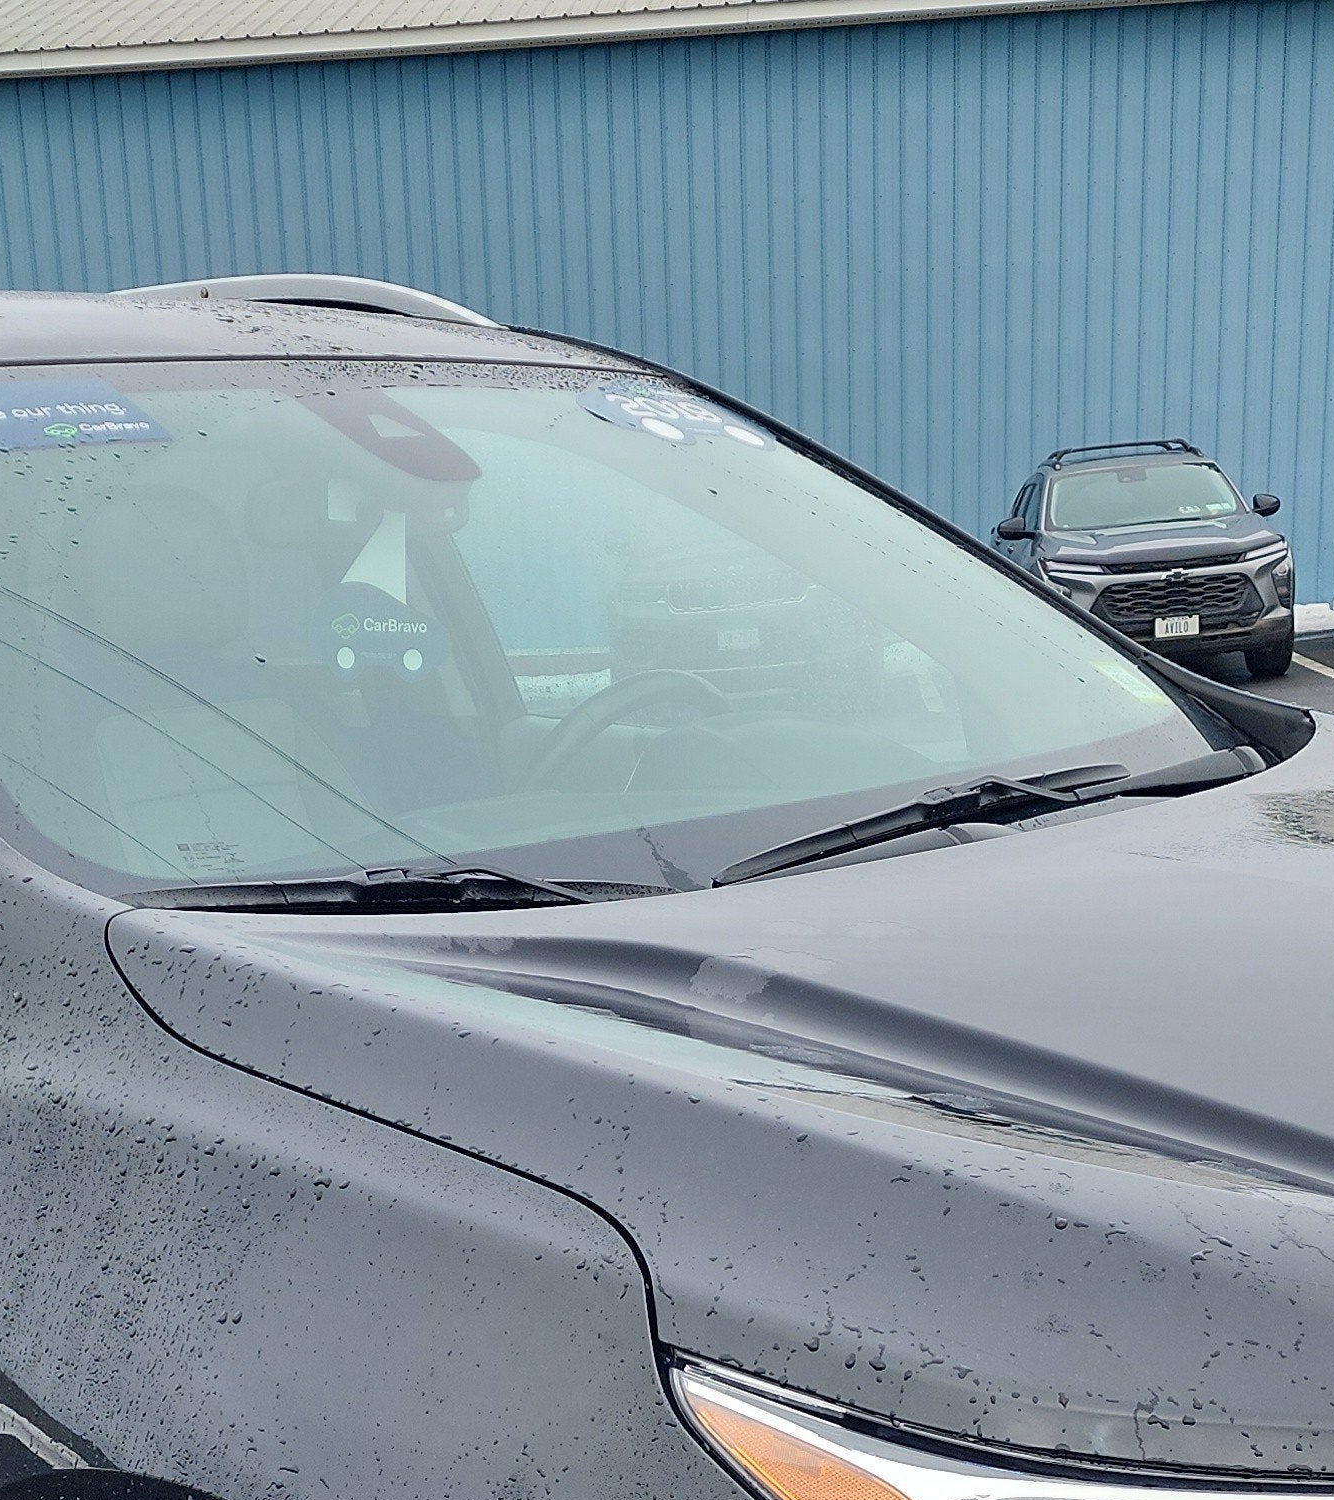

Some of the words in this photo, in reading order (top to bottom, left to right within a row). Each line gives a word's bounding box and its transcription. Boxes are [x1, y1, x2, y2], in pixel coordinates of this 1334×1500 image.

[10, 404, 53, 419] our
[55, 402, 128, 417] thing.
[78, 420, 150, 433] CarBravo
[363, 617, 428, 634] CarBravo
